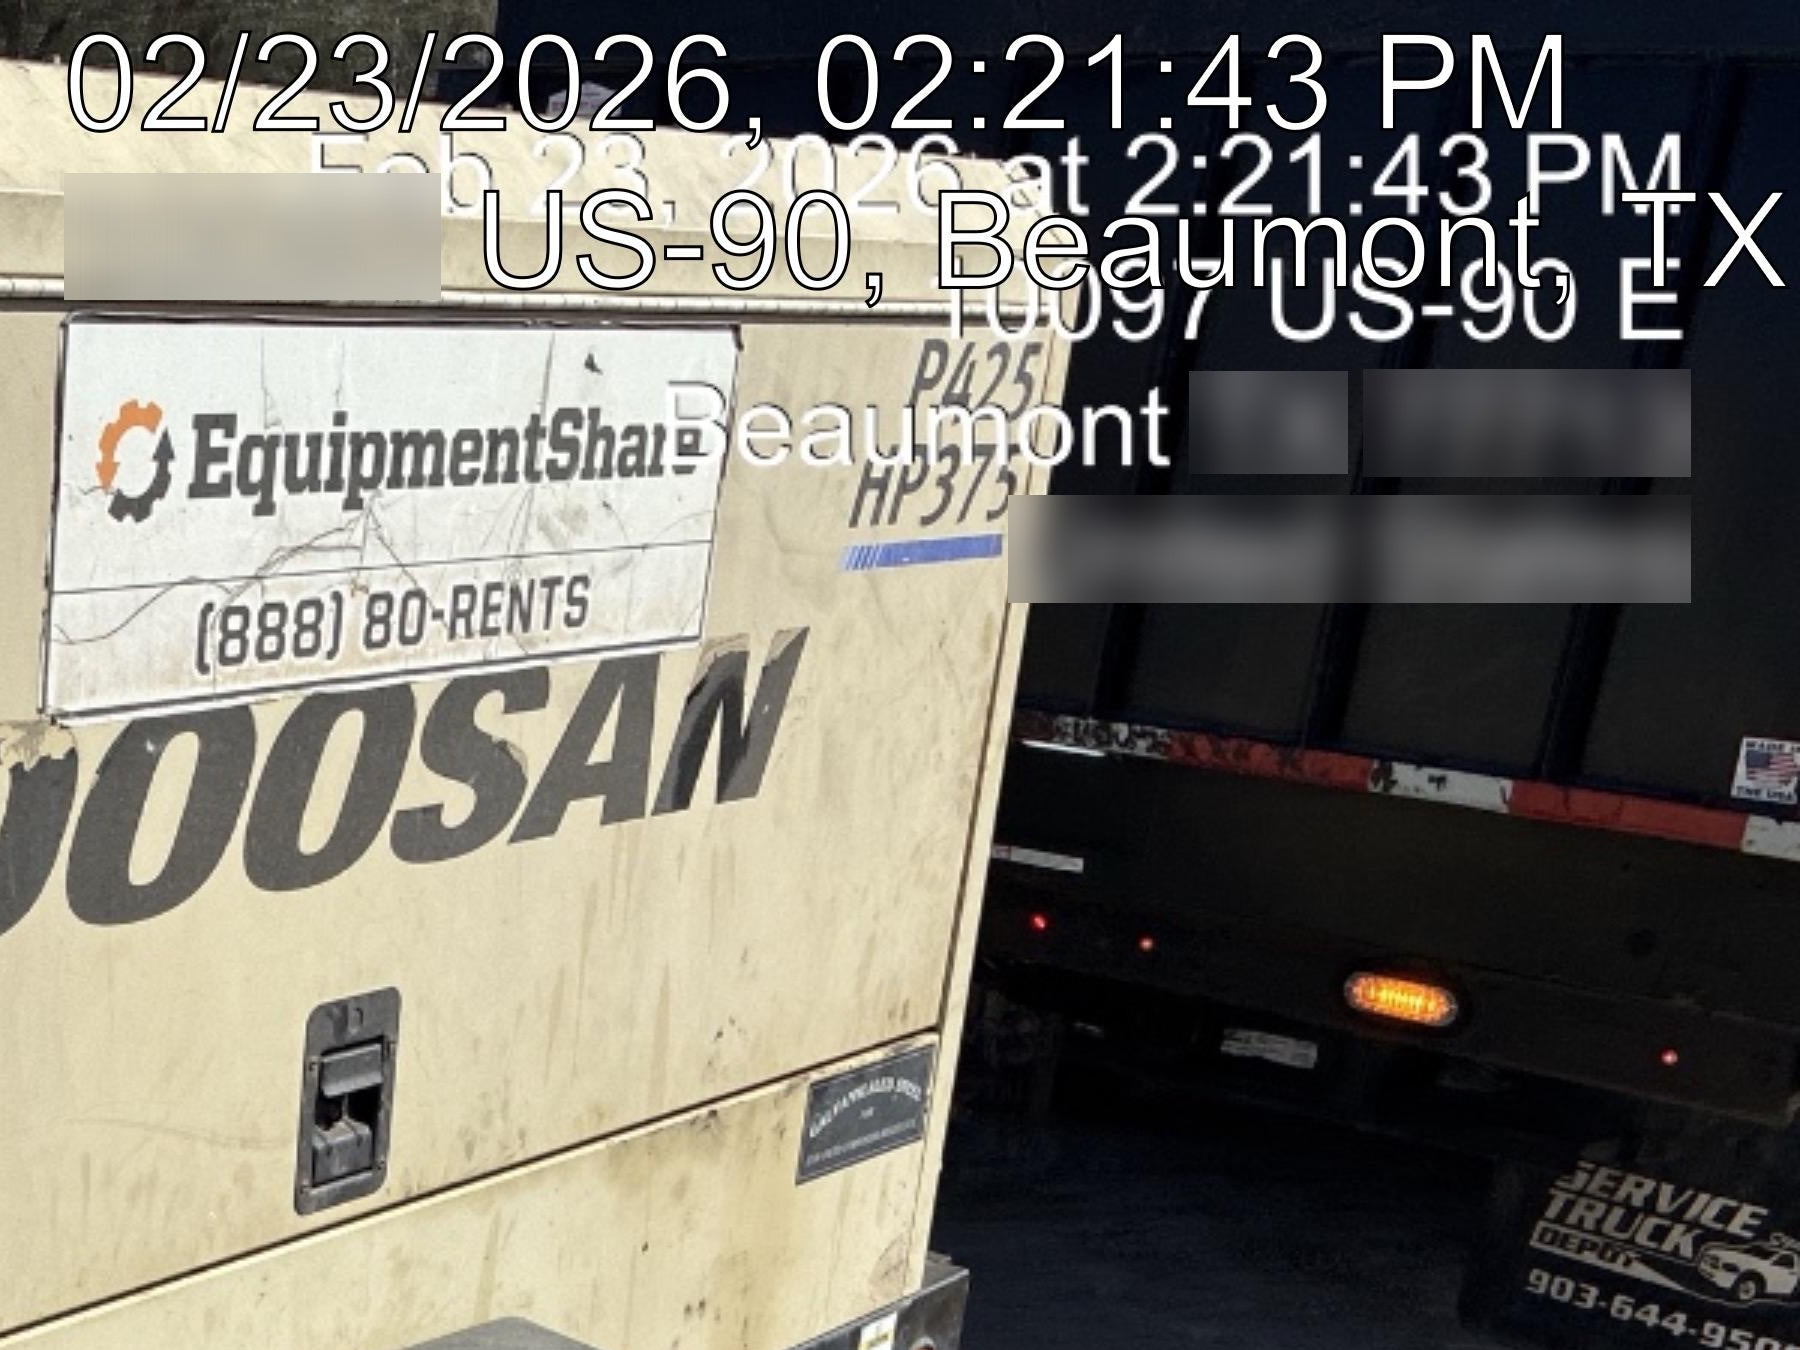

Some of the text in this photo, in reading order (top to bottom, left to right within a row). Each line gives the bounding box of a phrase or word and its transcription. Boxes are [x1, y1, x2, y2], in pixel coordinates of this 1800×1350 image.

[909, 338, 1042, 425] P425
[187, 406, 703, 516] EquipmentShare
[195, 574, 590, 675] (888) 80-RENTS
[1543, 1187, 1703, 1260] TRUCK
[1553, 1160, 1768, 1238] SERVICE
[1536, 1226, 1642, 1269] DEPOT
